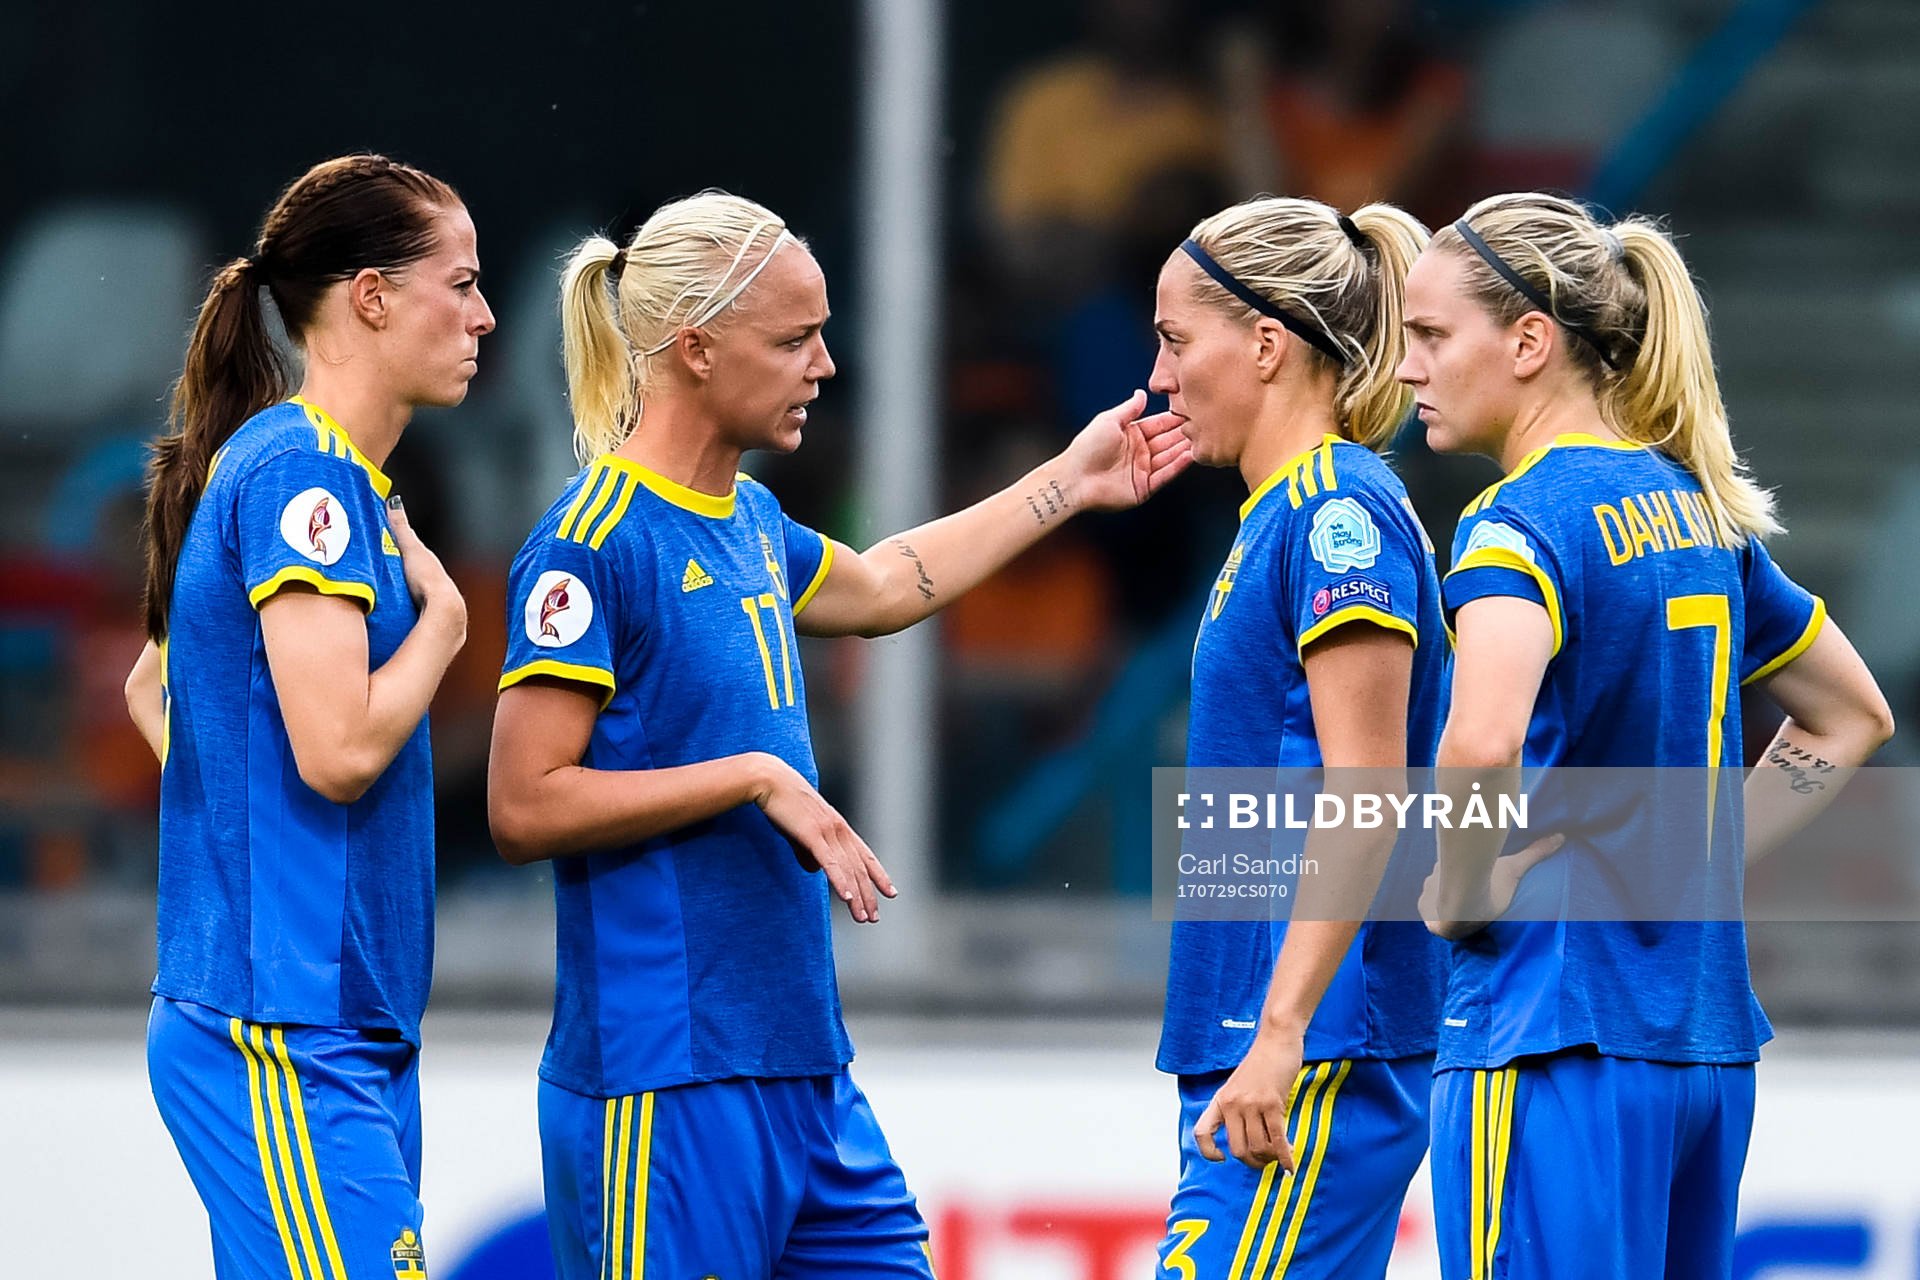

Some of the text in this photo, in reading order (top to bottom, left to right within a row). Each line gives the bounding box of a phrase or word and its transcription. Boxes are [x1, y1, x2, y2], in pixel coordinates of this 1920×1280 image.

[1331, 531, 1351, 540] play
[1592, 490, 1724, 567] DAHLKVI
[1331, 581, 1390, 604] RESPECT
[741, 593, 794, 710] 17
[1666, 594, 1731, 862] 7
[1163, 1219, 1211, 1280] 3
